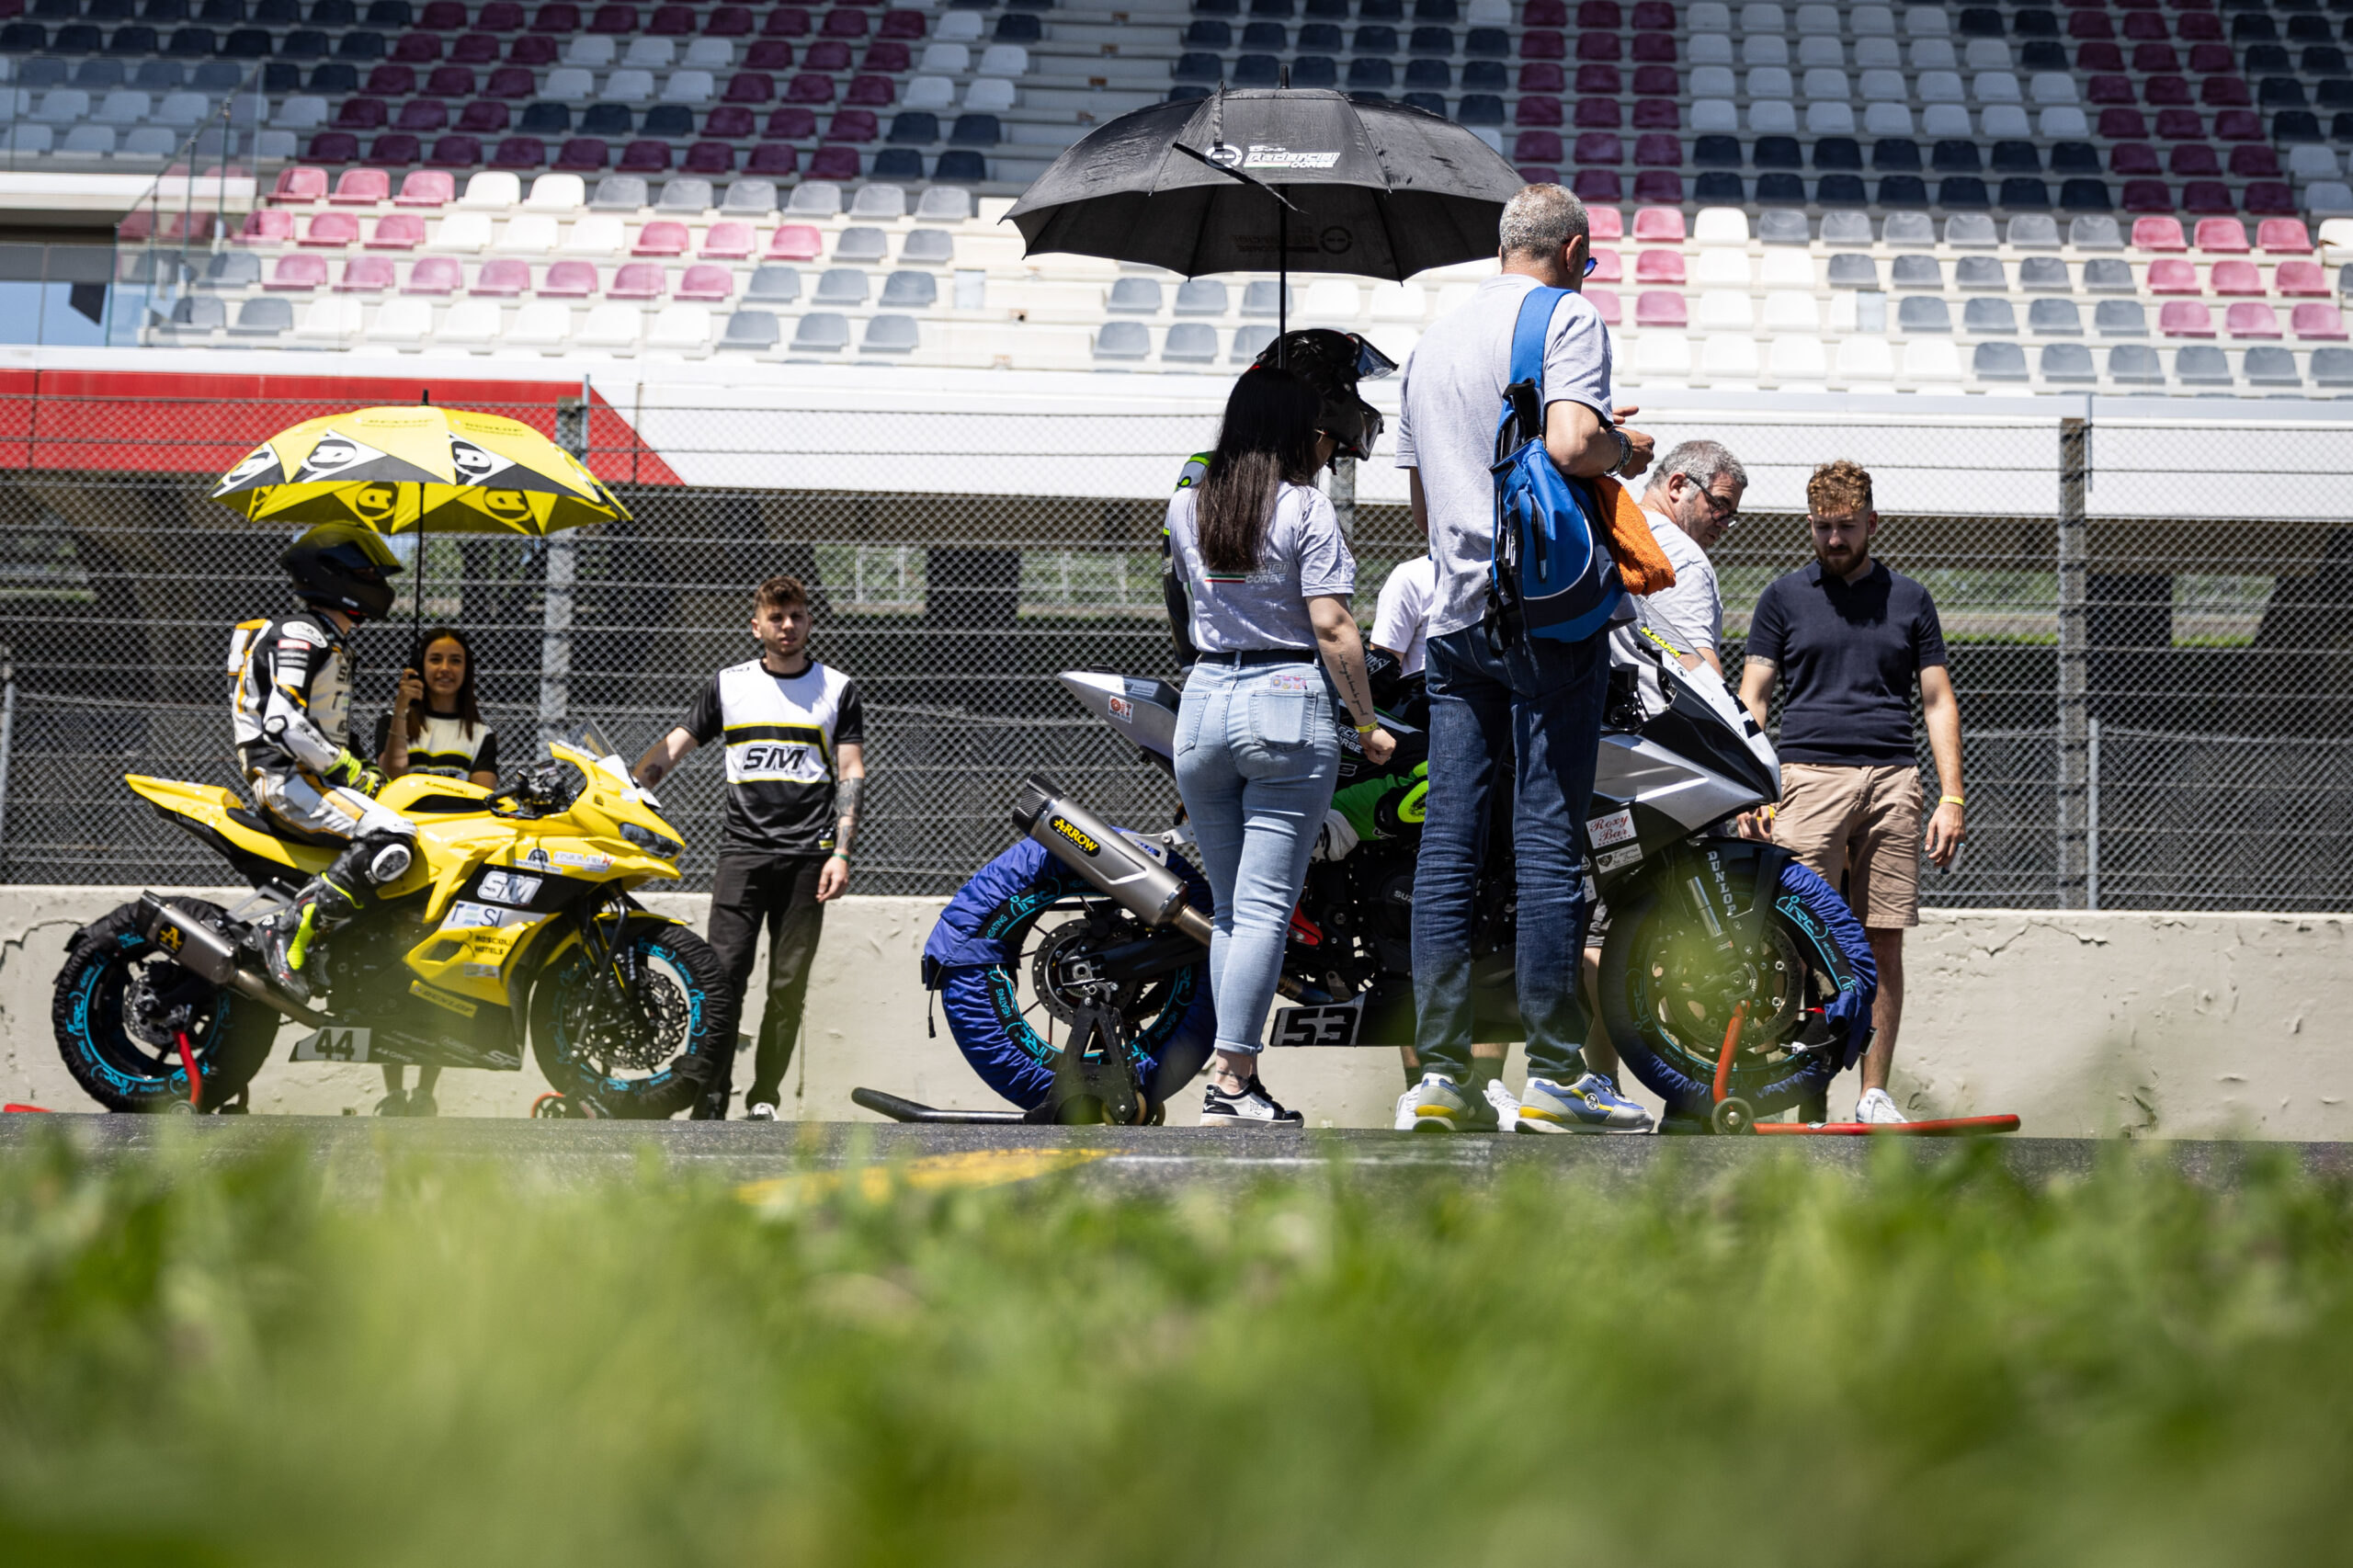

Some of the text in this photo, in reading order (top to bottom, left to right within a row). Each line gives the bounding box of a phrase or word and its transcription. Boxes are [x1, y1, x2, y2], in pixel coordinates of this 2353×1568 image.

[1245, 573, 1287, 585] CORSE
[743, 745, 810, 771] SM
[1054, 818, 1099, 852] ARROW
[1589, 815, 1629, 833] Roxy
[1598, 826, 1628, 842] Bar
[477, 870, 543, 905] SM
[1707, 850, 1737, 916] DUNLOP
[985, 914, 1008, 940] HEATING
[1823, 940, 1838, 964] HEATING
[995, 988, 1013, 1018] HEATING
[1282, 1006, 1358, 1046] 53
[315, 1028, 355, 1062] 44
